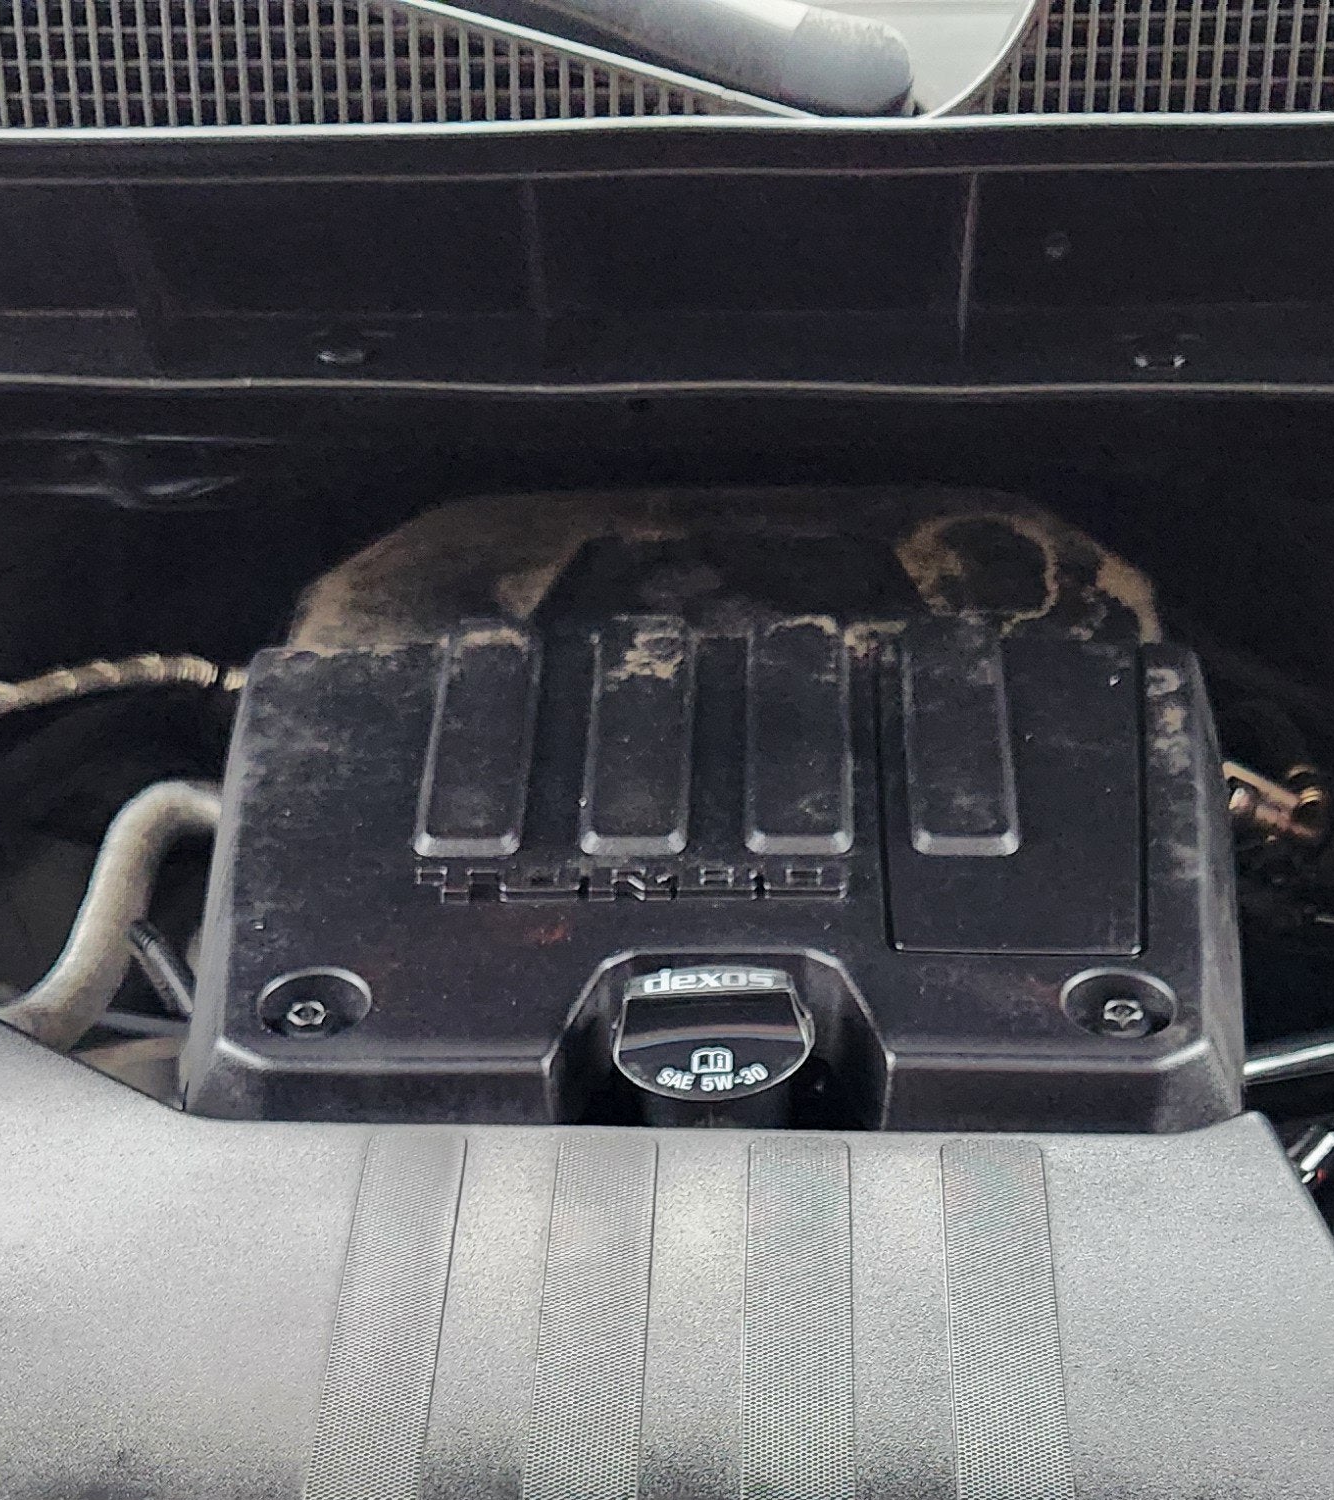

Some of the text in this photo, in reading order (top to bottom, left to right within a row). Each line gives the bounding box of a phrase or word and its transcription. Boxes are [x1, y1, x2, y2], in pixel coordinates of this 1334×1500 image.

[415, 864, 850, 902] TURBO
[643, 968, 774, 993] dexos
[656, 1063, 769, 1092] SAE 5W-30
